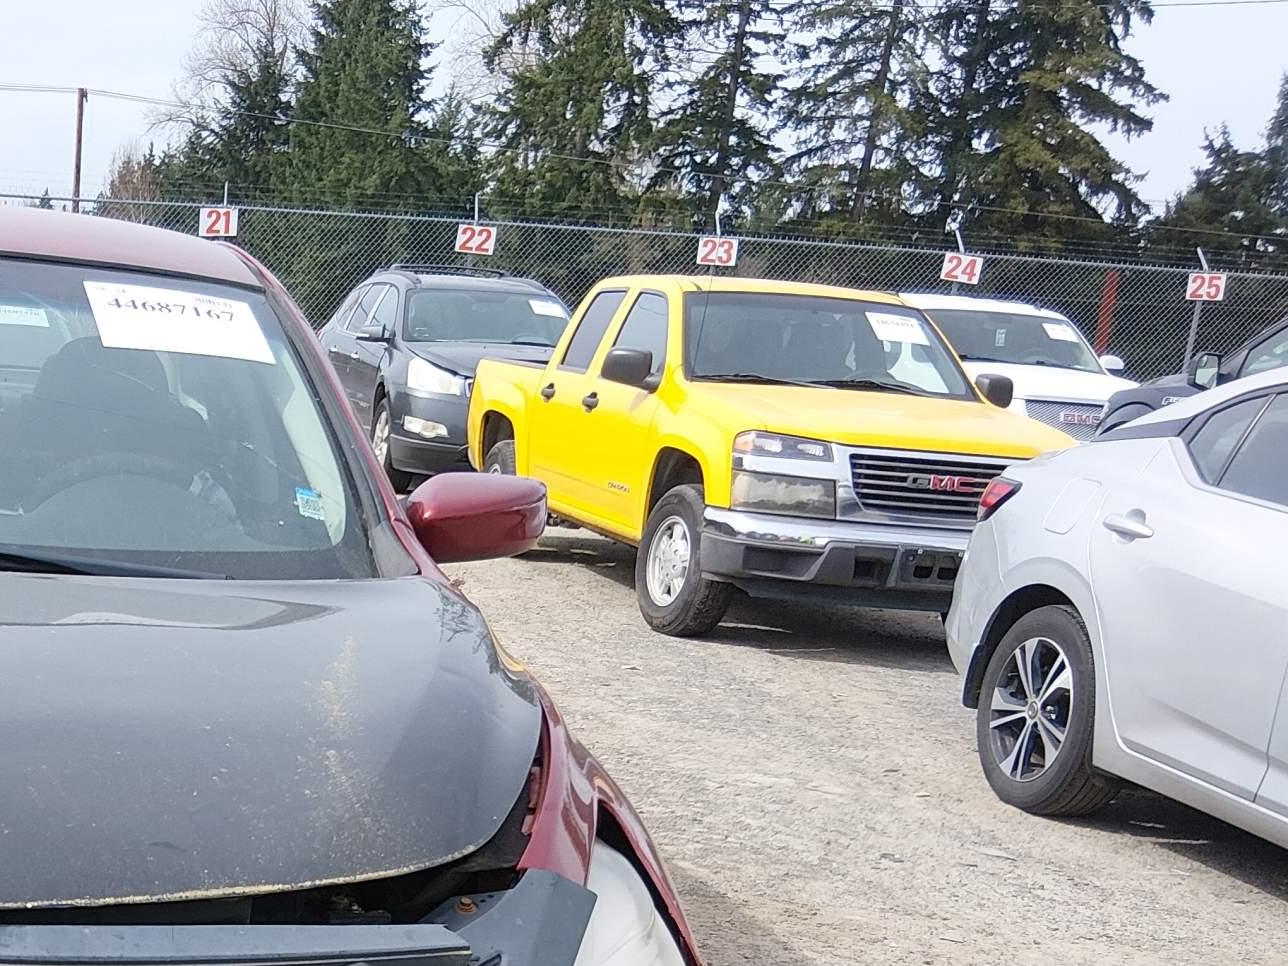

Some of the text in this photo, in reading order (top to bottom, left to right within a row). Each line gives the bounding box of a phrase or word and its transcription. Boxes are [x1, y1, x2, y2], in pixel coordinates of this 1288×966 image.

[205, 209, 232, 236] 21
[458, 225, 493, 254] 22
[700, 238, 735, 266] 23
[944, 254, 978, 283] 24
[1190, 274, 1222, 301] 25
[107, 297, 235, 322] 44687167
[1062, 412, 1101, 426] GMC
[907, 473, 975, 493] GMC
